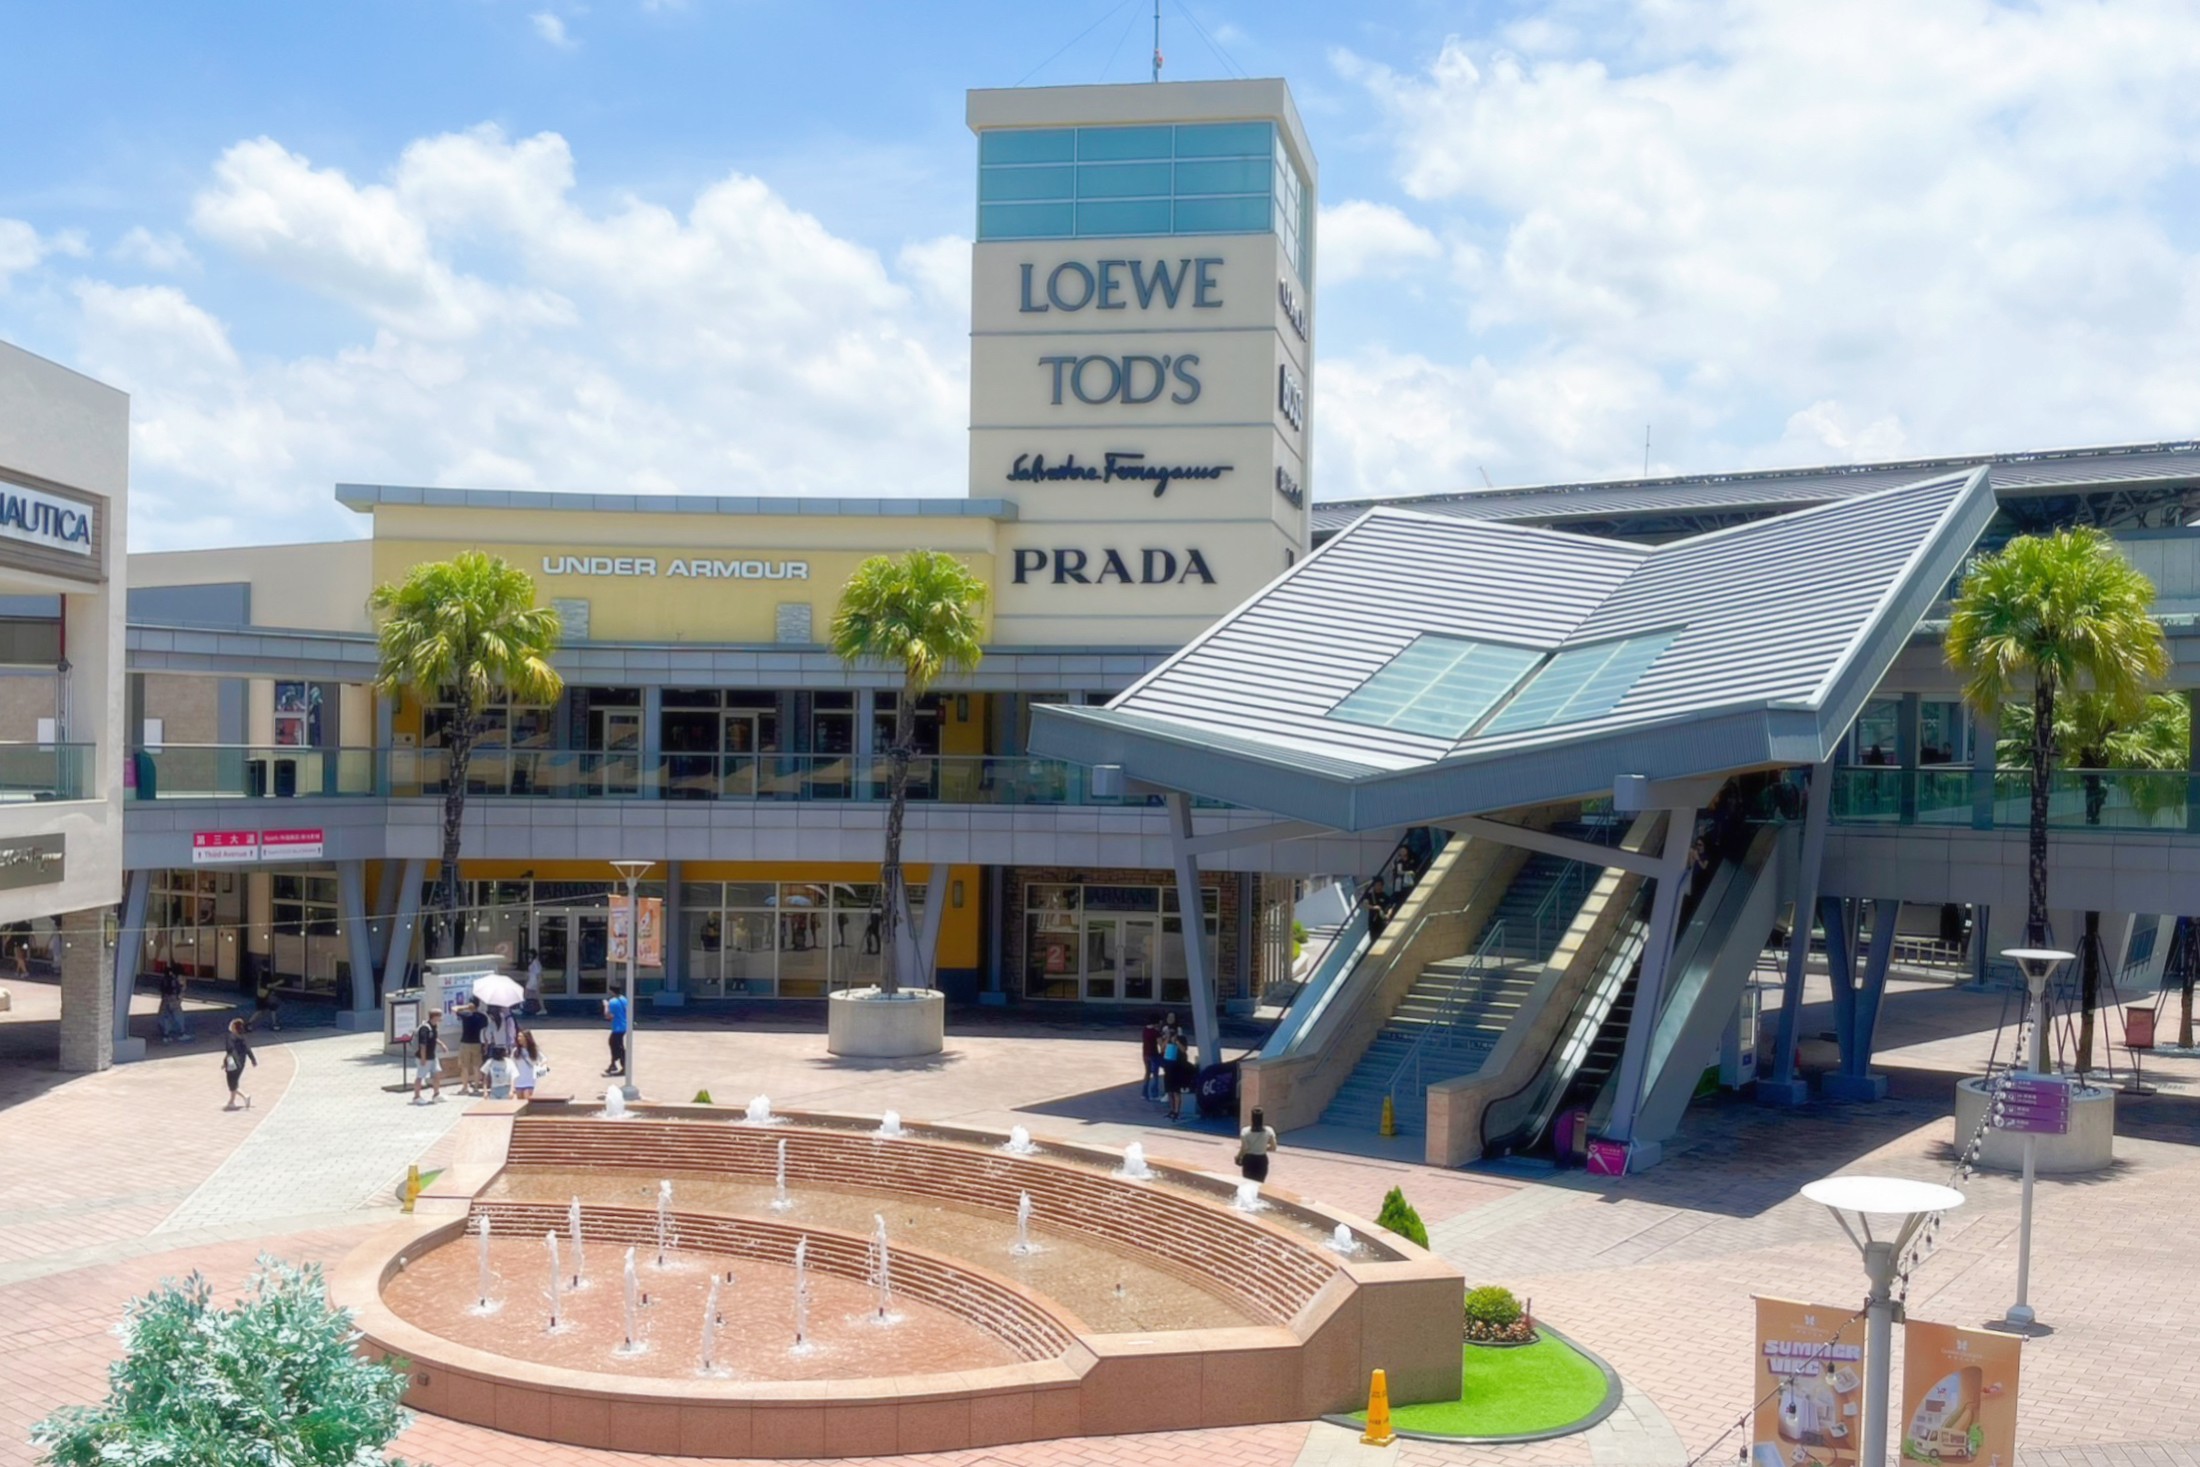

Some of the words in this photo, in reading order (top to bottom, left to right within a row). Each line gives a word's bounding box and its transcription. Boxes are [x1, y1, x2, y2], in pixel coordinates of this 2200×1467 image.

[1019, 258, 1224, 312] LOEWE
[1038, 354, 1201, 405] TOD'S
[1006, 454, 1102, 483] Salvatore
[1103, 453, 1234, 498] Ferragamo
[543, 556, 656, 576] UNDER
[666, 559, 808, 579] ARMOUR
[1011, 548, 1217, 585] PRADA
[1047, 946, 1061, 963] 2
[1202, 1078, 1217, 1096] 6C
[1763, 1340, 1861, 1361] SUMMER
